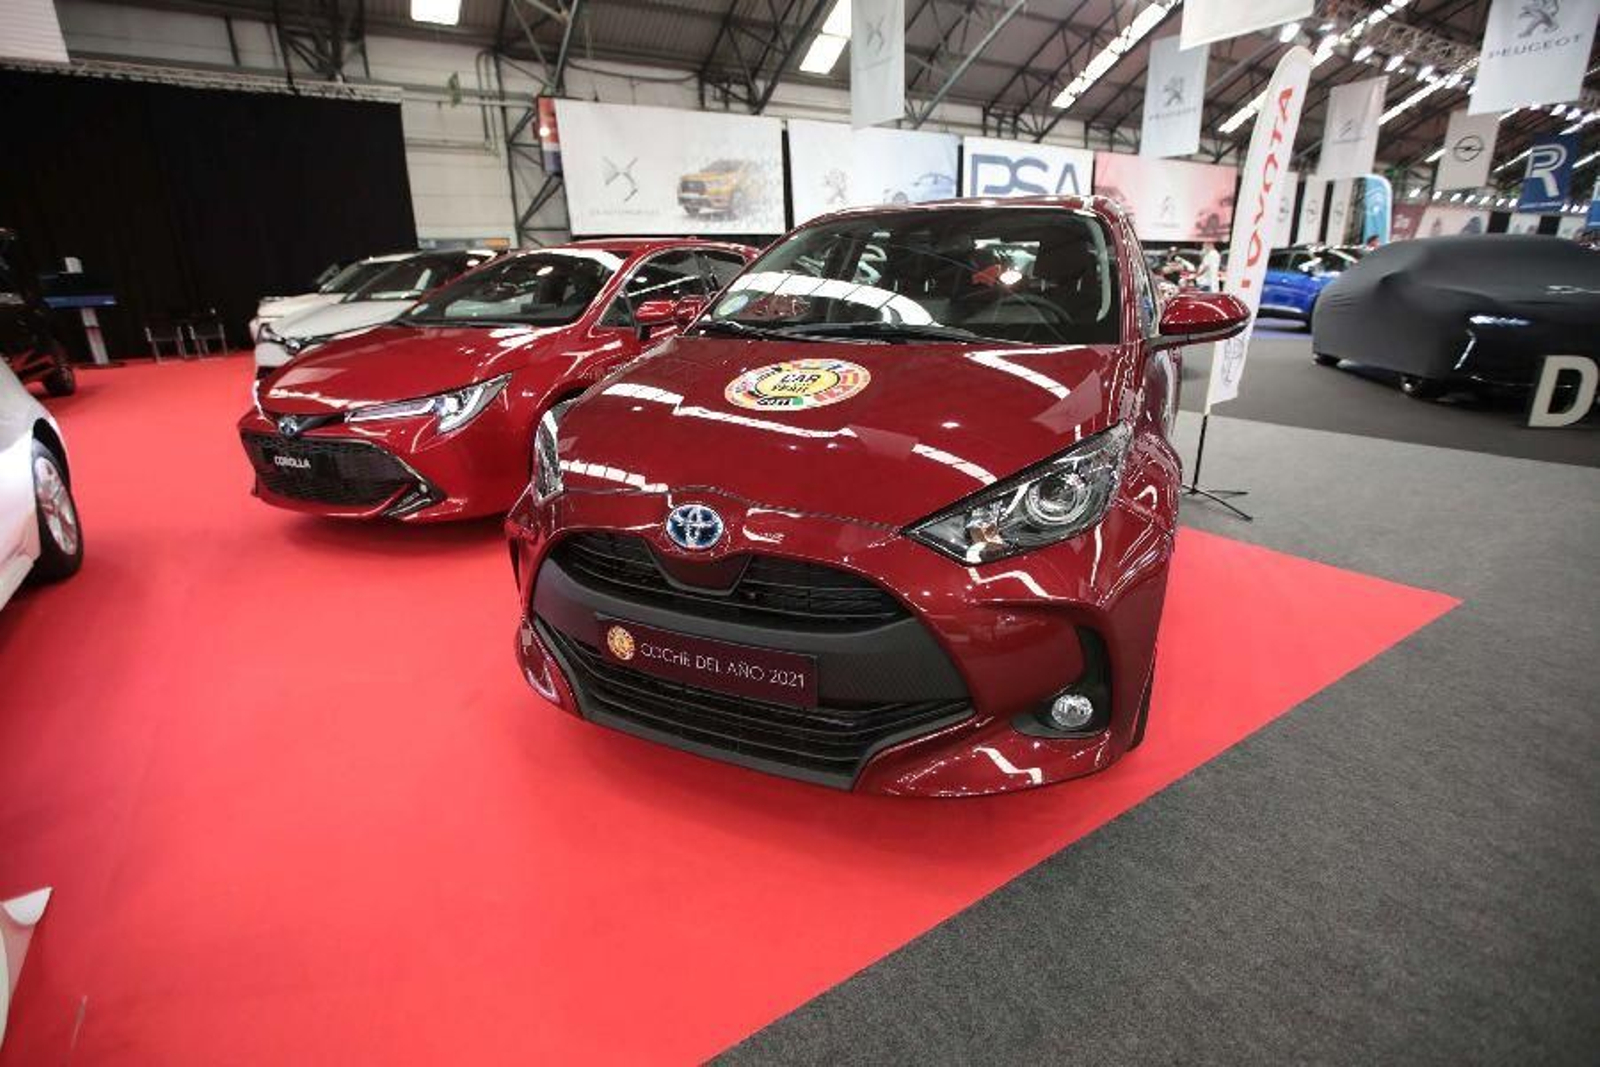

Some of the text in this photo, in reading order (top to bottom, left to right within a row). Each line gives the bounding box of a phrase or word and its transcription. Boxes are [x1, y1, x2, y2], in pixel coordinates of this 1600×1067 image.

[1488, 33, 1583, 58] PEUGEOT
[970, 153, 1080, 198] PSA
[1524, 144, 1567, 197] R
[274, 455, 312, 470] COROLLA
[640, 642, 804, 690] COCHE DEL AÑO 2021
